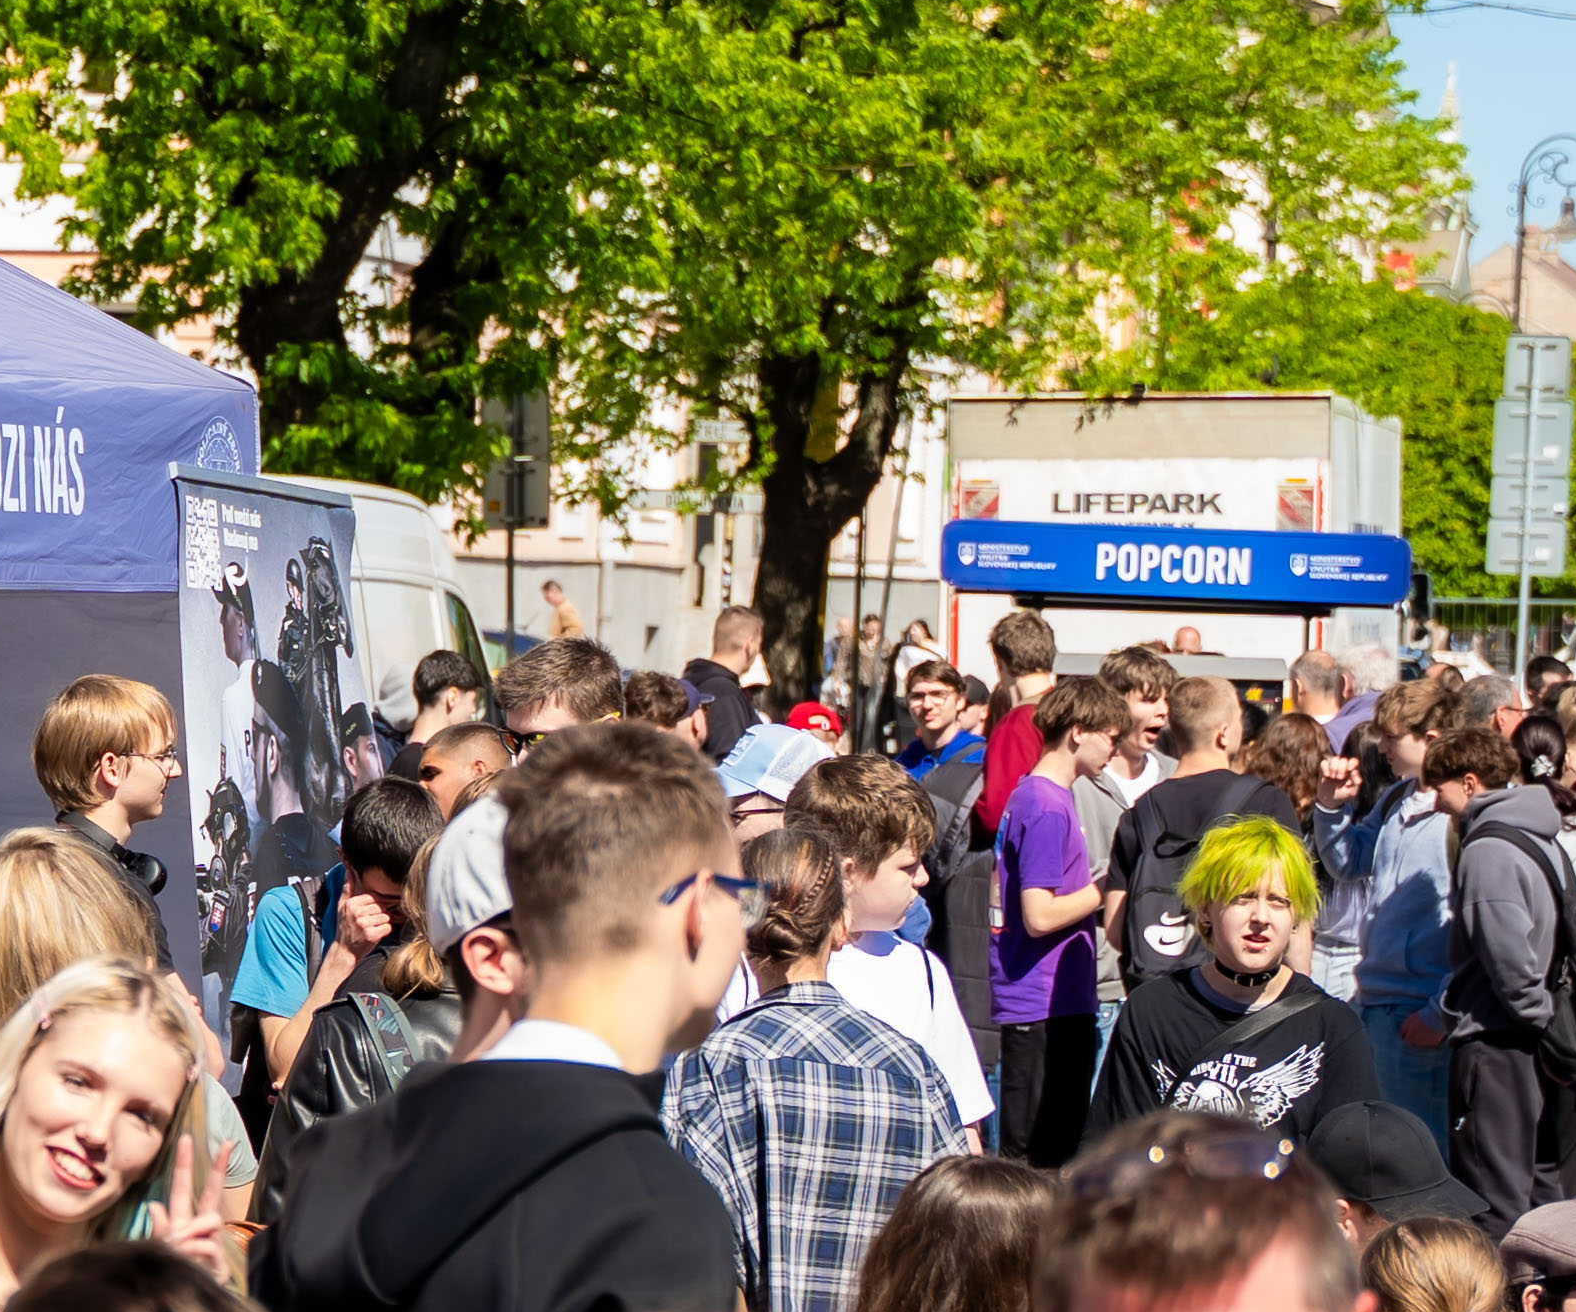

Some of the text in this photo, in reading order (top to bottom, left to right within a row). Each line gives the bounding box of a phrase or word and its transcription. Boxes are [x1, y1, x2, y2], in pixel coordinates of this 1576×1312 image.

[32, 405, 86, 517] NÁS
[1052, 492, 1223, 515] LIFEPARK
[1095, 542, 1252, 585] POPCORN
